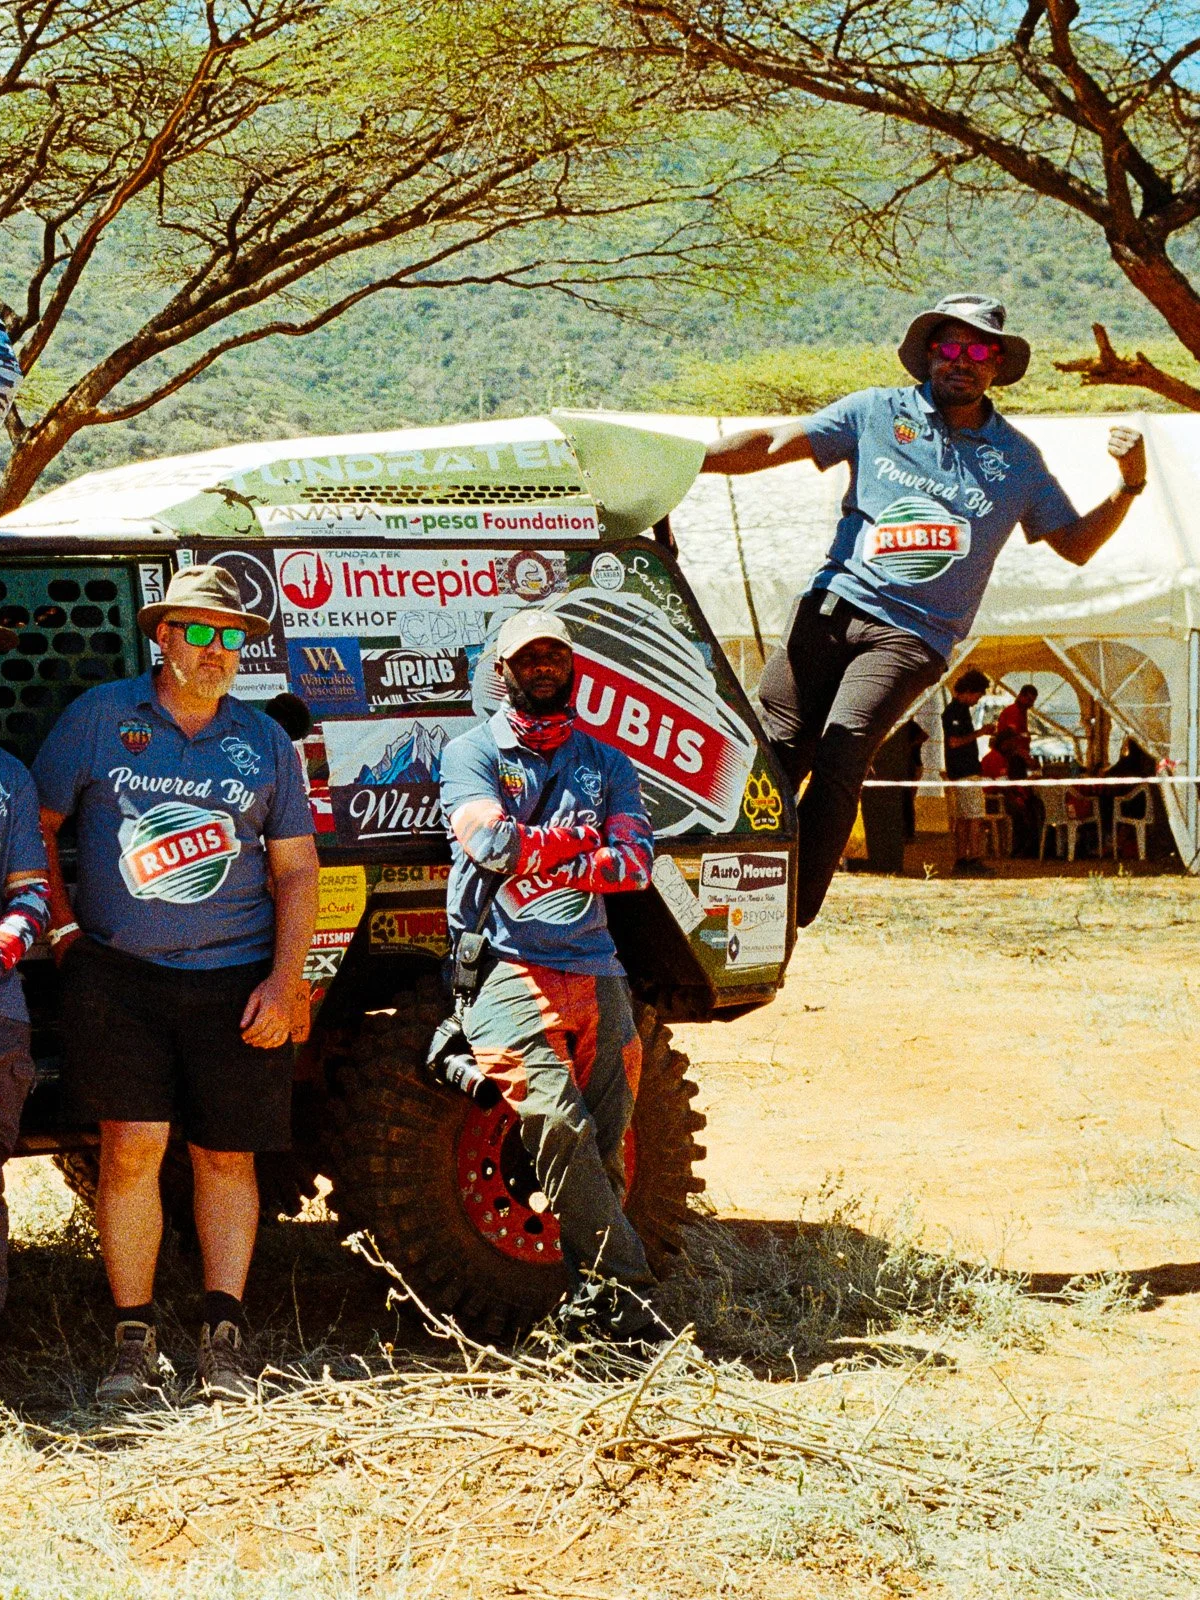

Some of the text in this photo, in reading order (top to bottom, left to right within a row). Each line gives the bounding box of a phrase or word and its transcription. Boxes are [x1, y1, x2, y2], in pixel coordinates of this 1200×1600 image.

[874, 456, 994, 517] Powered By
[483, 511, 595, 531] Foundation
[326, 550, 400, 559] TUNDRATEK
[342, 559, 500, 606] Intrepid
[301, 646, 347, 672] WA
[380, 656, 456, 687] JIPJAB
[108, 766, 257, 813] Powered By
[710, 863, 784, 879] Auto Movers
